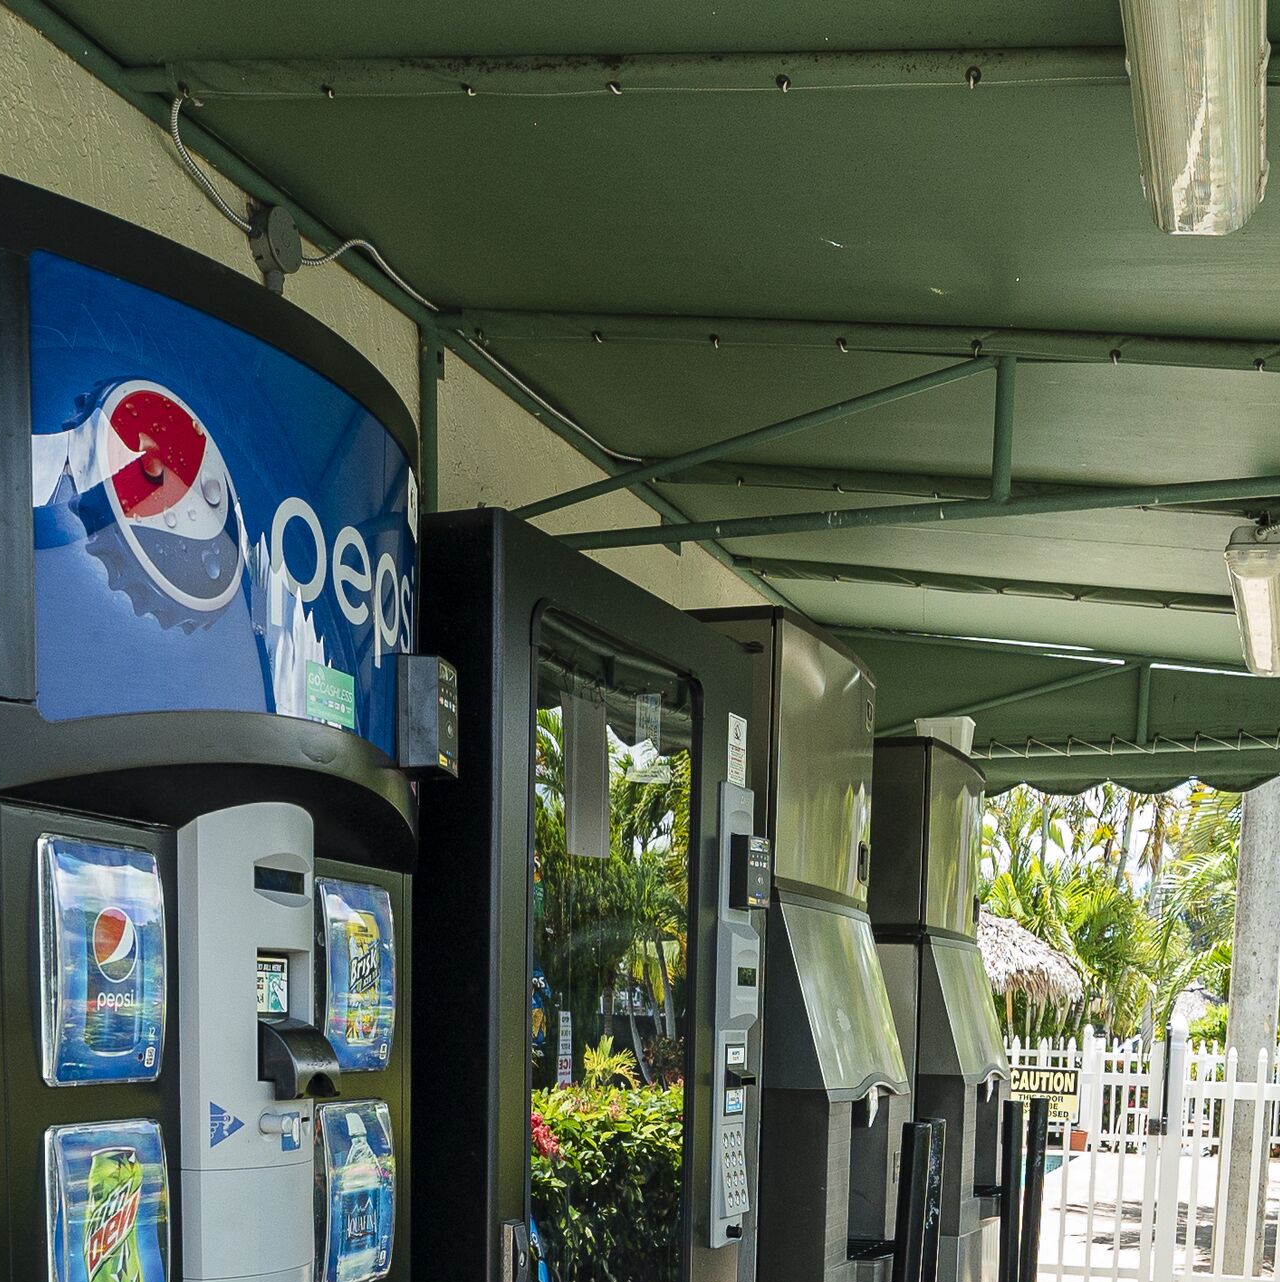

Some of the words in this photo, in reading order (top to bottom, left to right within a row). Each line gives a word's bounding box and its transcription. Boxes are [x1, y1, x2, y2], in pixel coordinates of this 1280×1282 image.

[271, 497, 415, 669] pepsi
[97, 989, 135, 1012] pepsi
[1010, 1070, 1075, 1092] CAUTION
